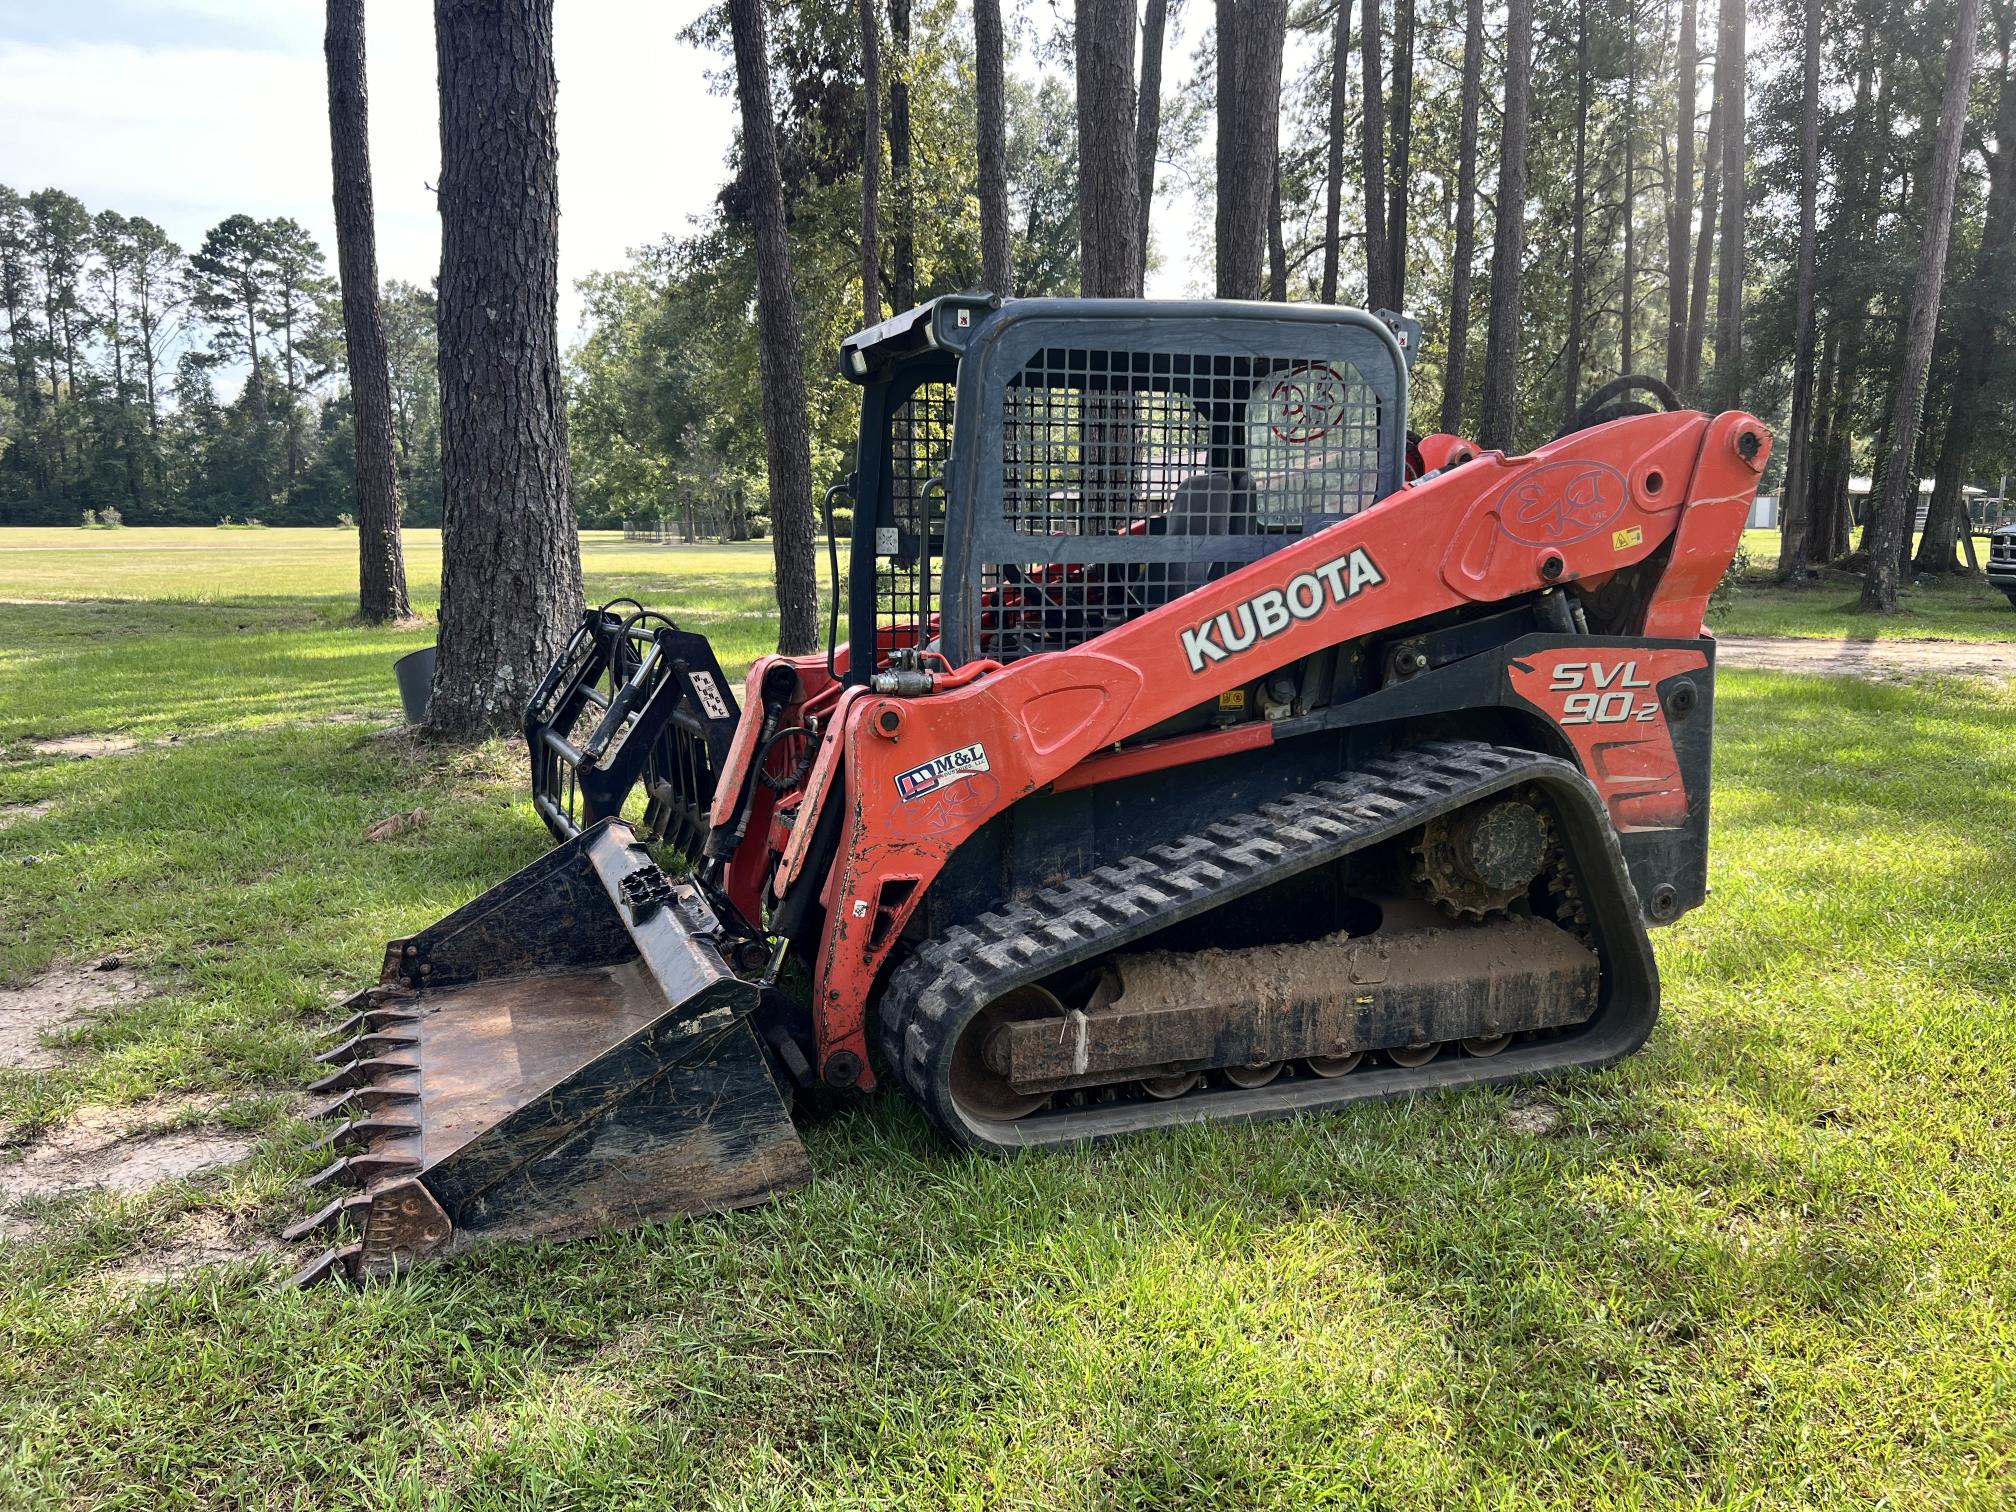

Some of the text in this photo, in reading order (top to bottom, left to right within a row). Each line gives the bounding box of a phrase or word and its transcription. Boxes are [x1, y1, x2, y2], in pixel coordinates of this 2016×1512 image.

[1181, 549, 1383, 672] KUBOTA
[1549, 662, 1651, 691] SVL
[1560, 692, 1659, 725] 90-2
[934, 747, 983, 774] M&L
